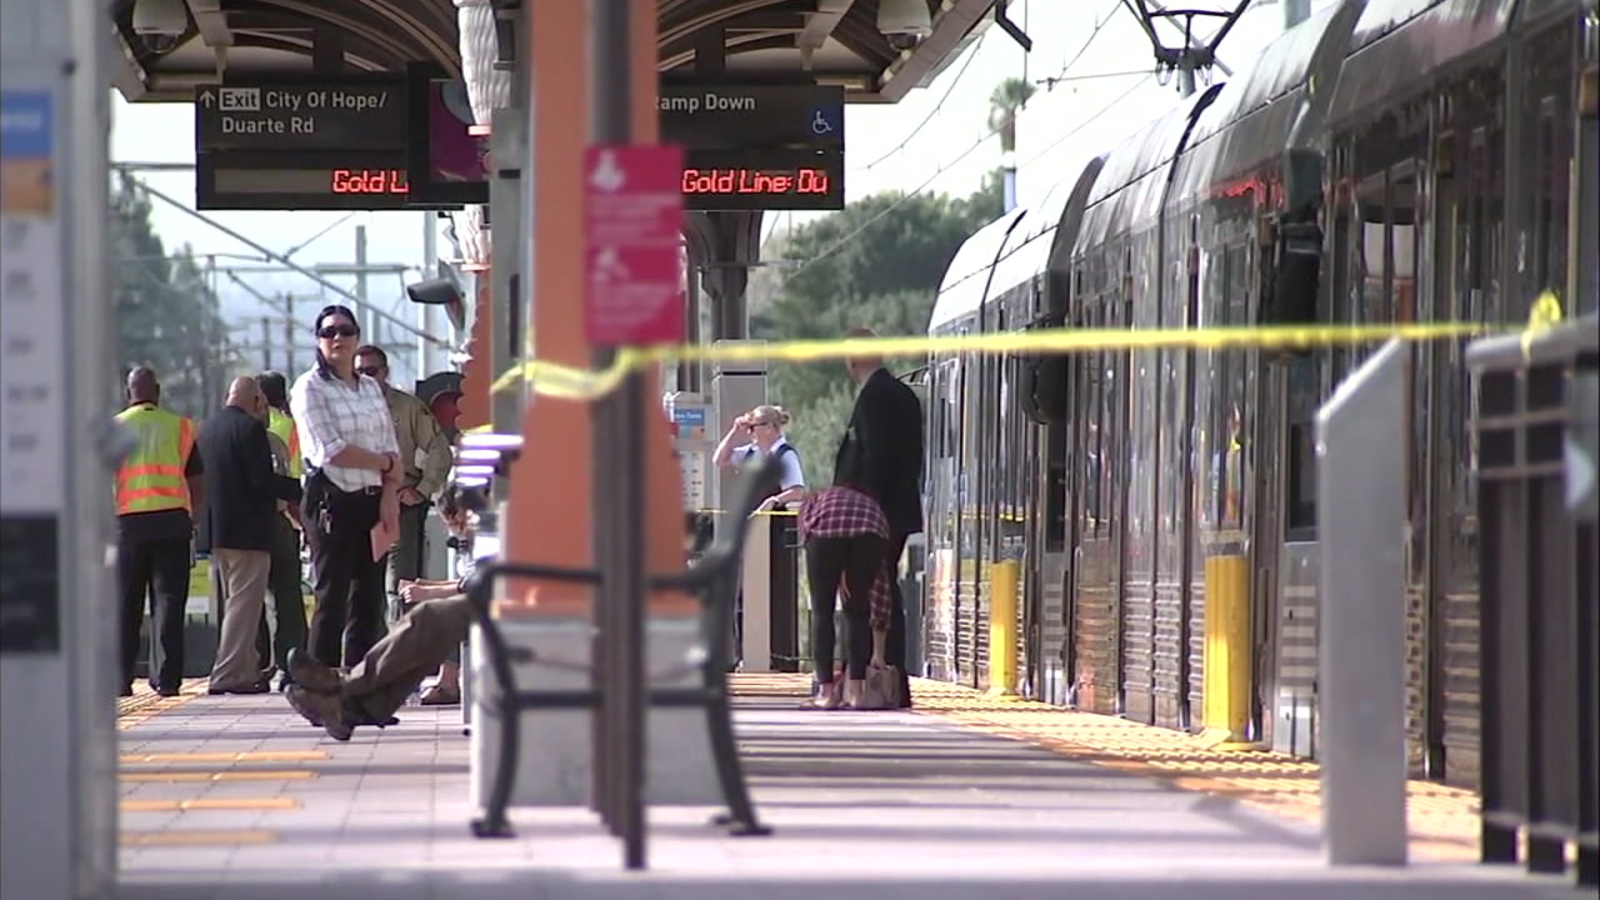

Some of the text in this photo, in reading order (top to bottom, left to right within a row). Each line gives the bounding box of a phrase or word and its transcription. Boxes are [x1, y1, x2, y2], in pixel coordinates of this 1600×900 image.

[221, 91, 387, 111] Exit City Of Hope/
[705, 94, 755, 110] Down
[222, 117, 314, 134] Duarte Rd
[332, 170, 409, 193] Gold L
[681, 169, 828, 195] Gold Line: Du
